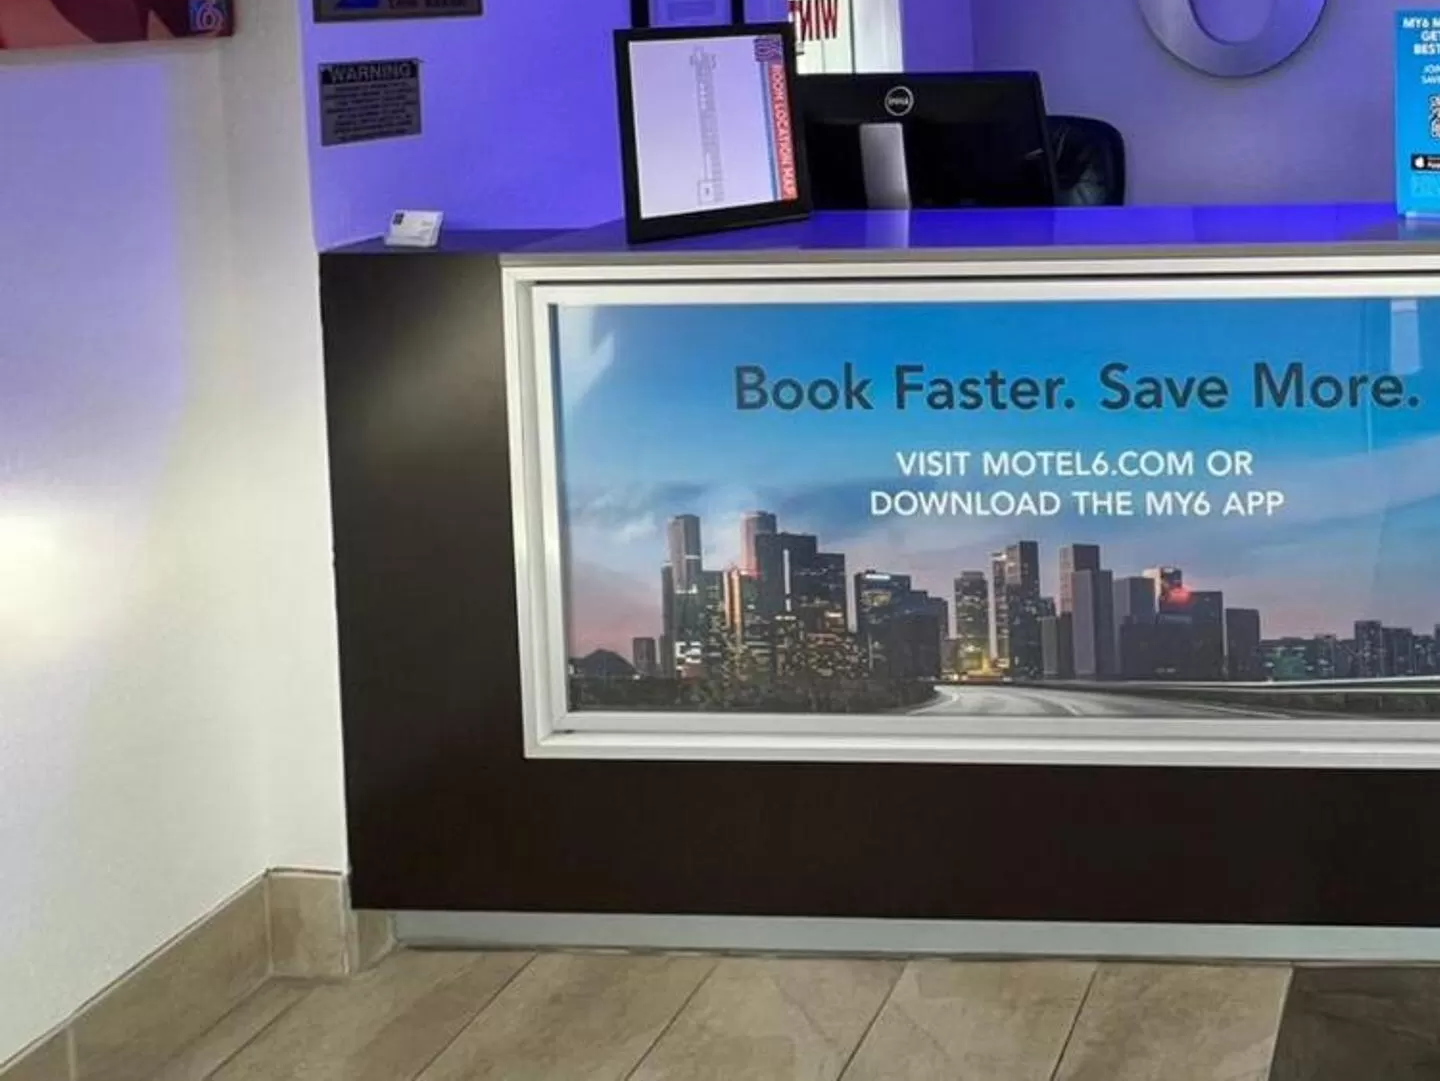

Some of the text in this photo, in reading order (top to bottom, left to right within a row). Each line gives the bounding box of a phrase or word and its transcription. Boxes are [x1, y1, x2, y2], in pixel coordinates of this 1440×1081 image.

[329, 64, 412, 84] WARNING
[774, 102, 792, 165] LOCATION
[734, 361, 1421, 411] Book Faster. Save More.
[896, 450, 1253, 477] VISIT MOTEL6.COM OR
[870, 491, 1285, 517] DOWNLOAD THE MY6 APP
